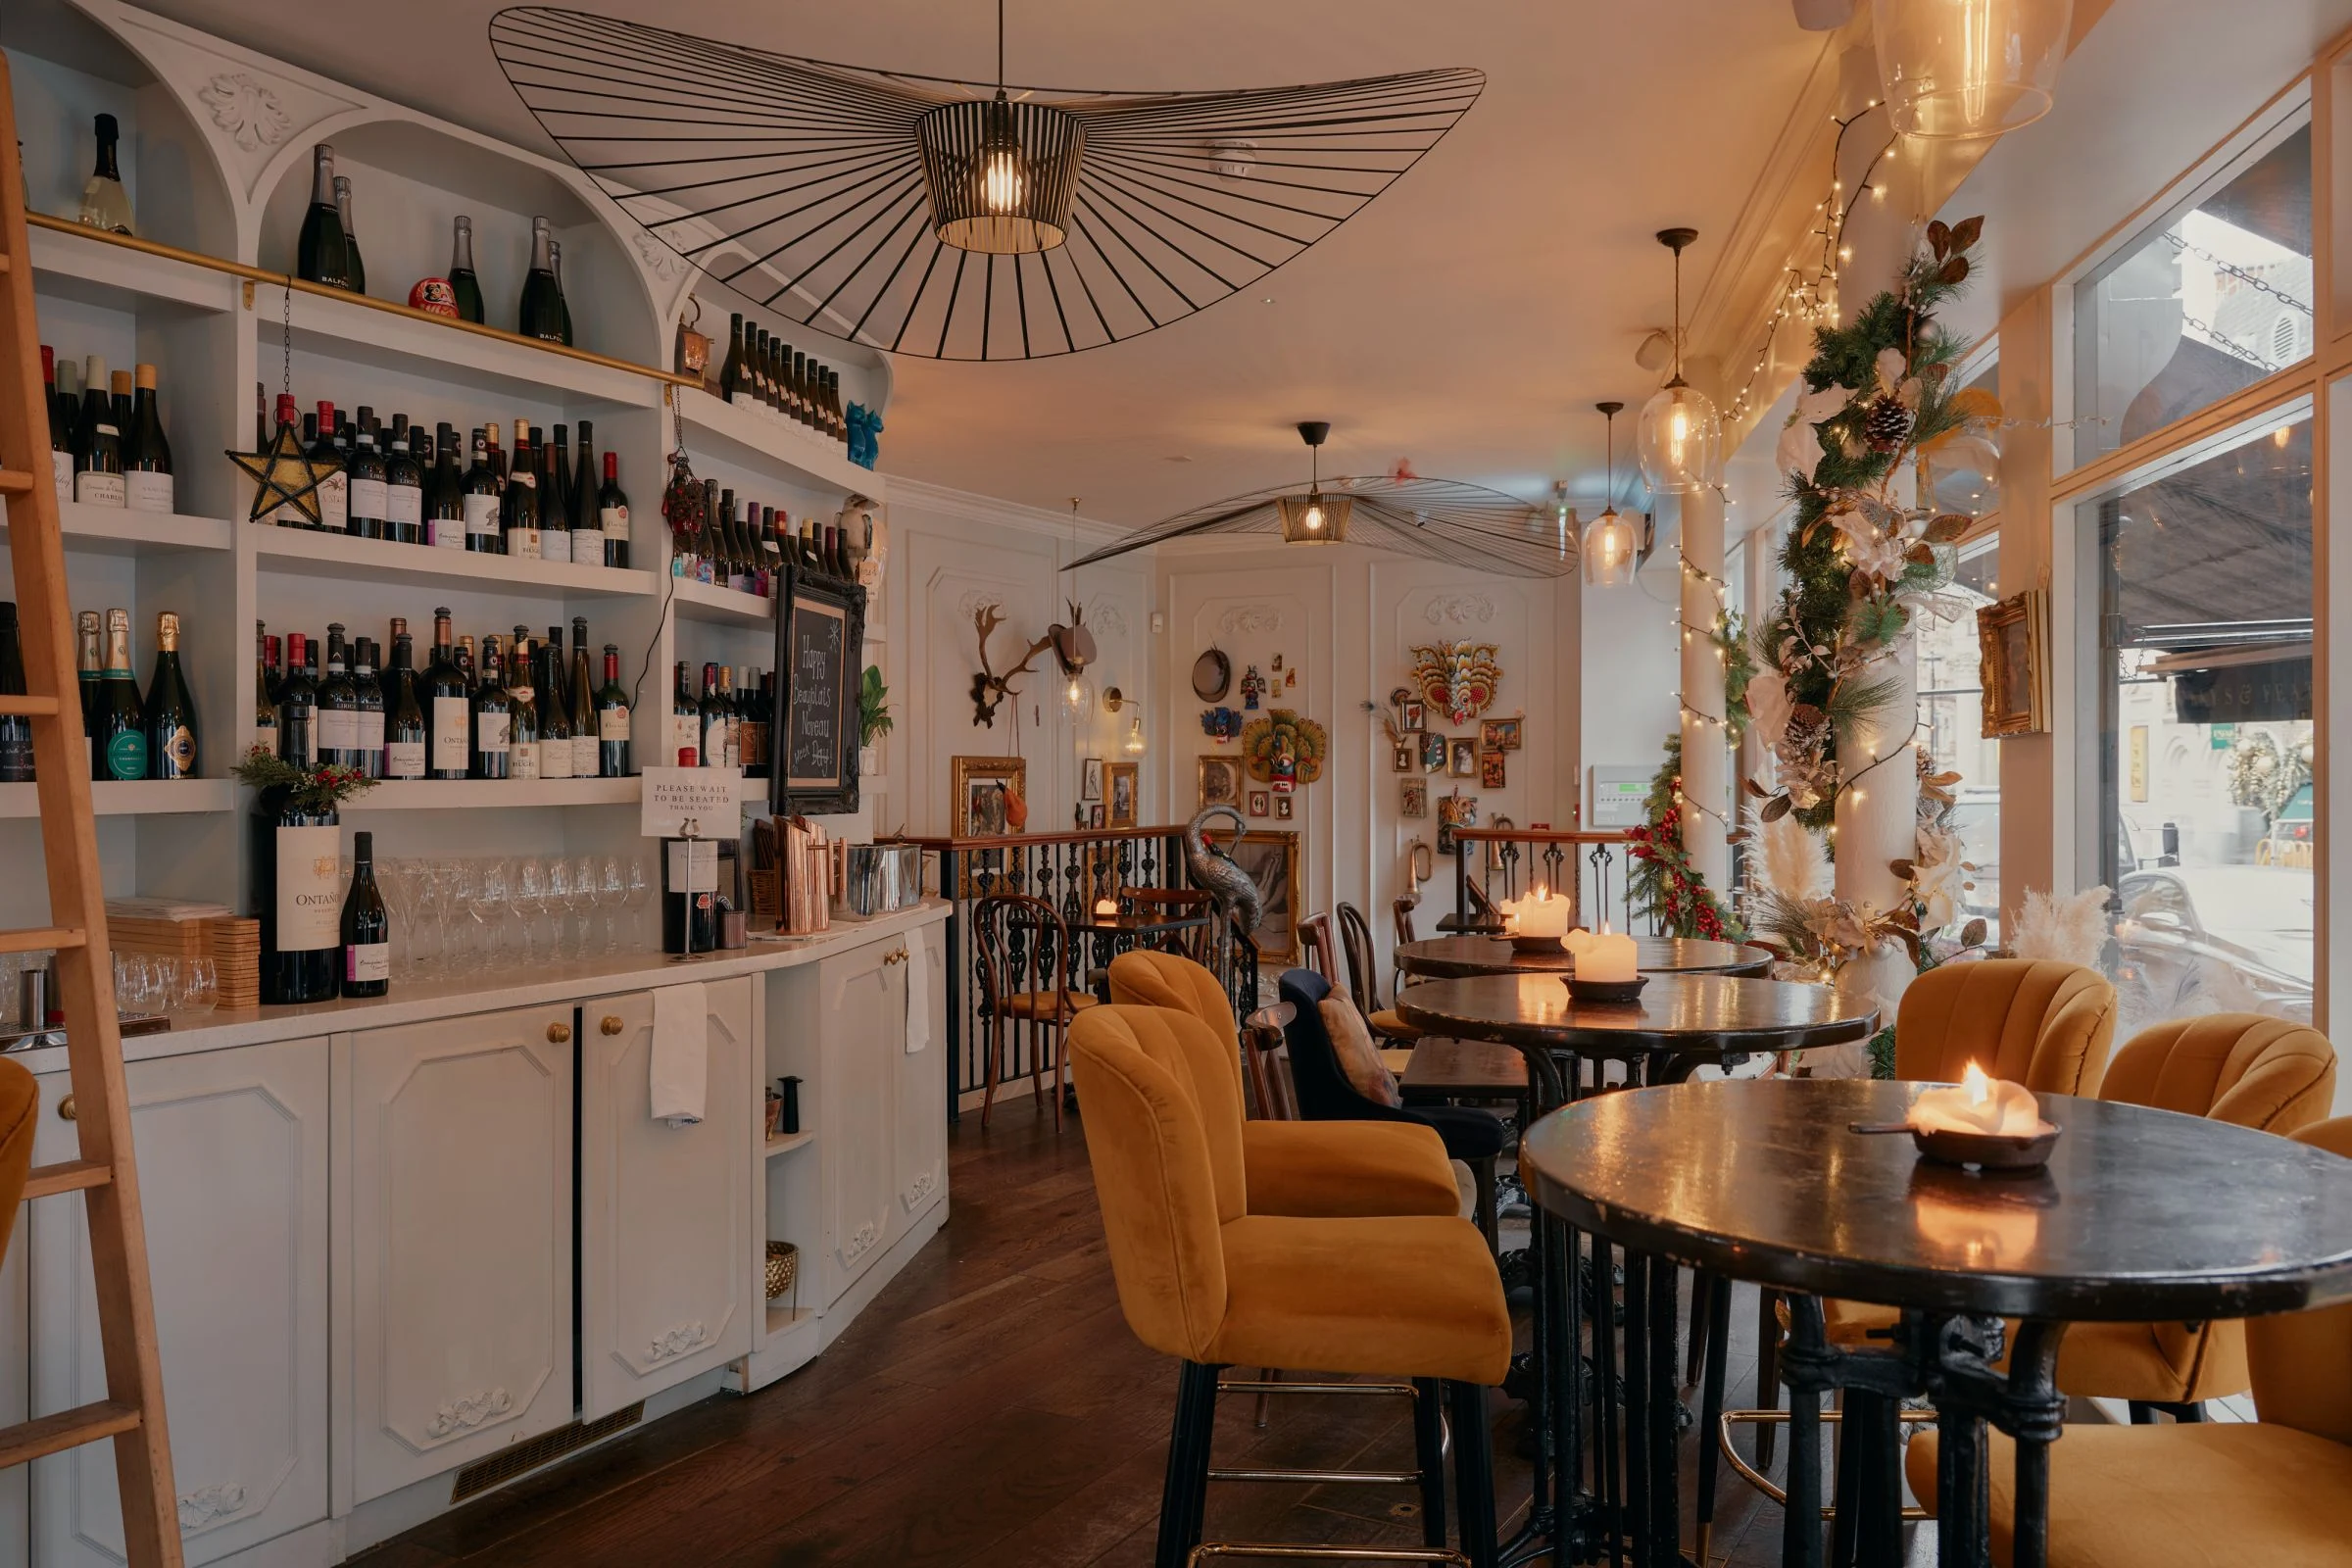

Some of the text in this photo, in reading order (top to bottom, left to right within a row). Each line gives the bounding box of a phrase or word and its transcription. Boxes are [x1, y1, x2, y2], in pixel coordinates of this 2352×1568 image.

[803, 634, 826, 680] Happy
[801, 710, 830, 737] Noveau
[657, 784, 695, 793] PLEASE
